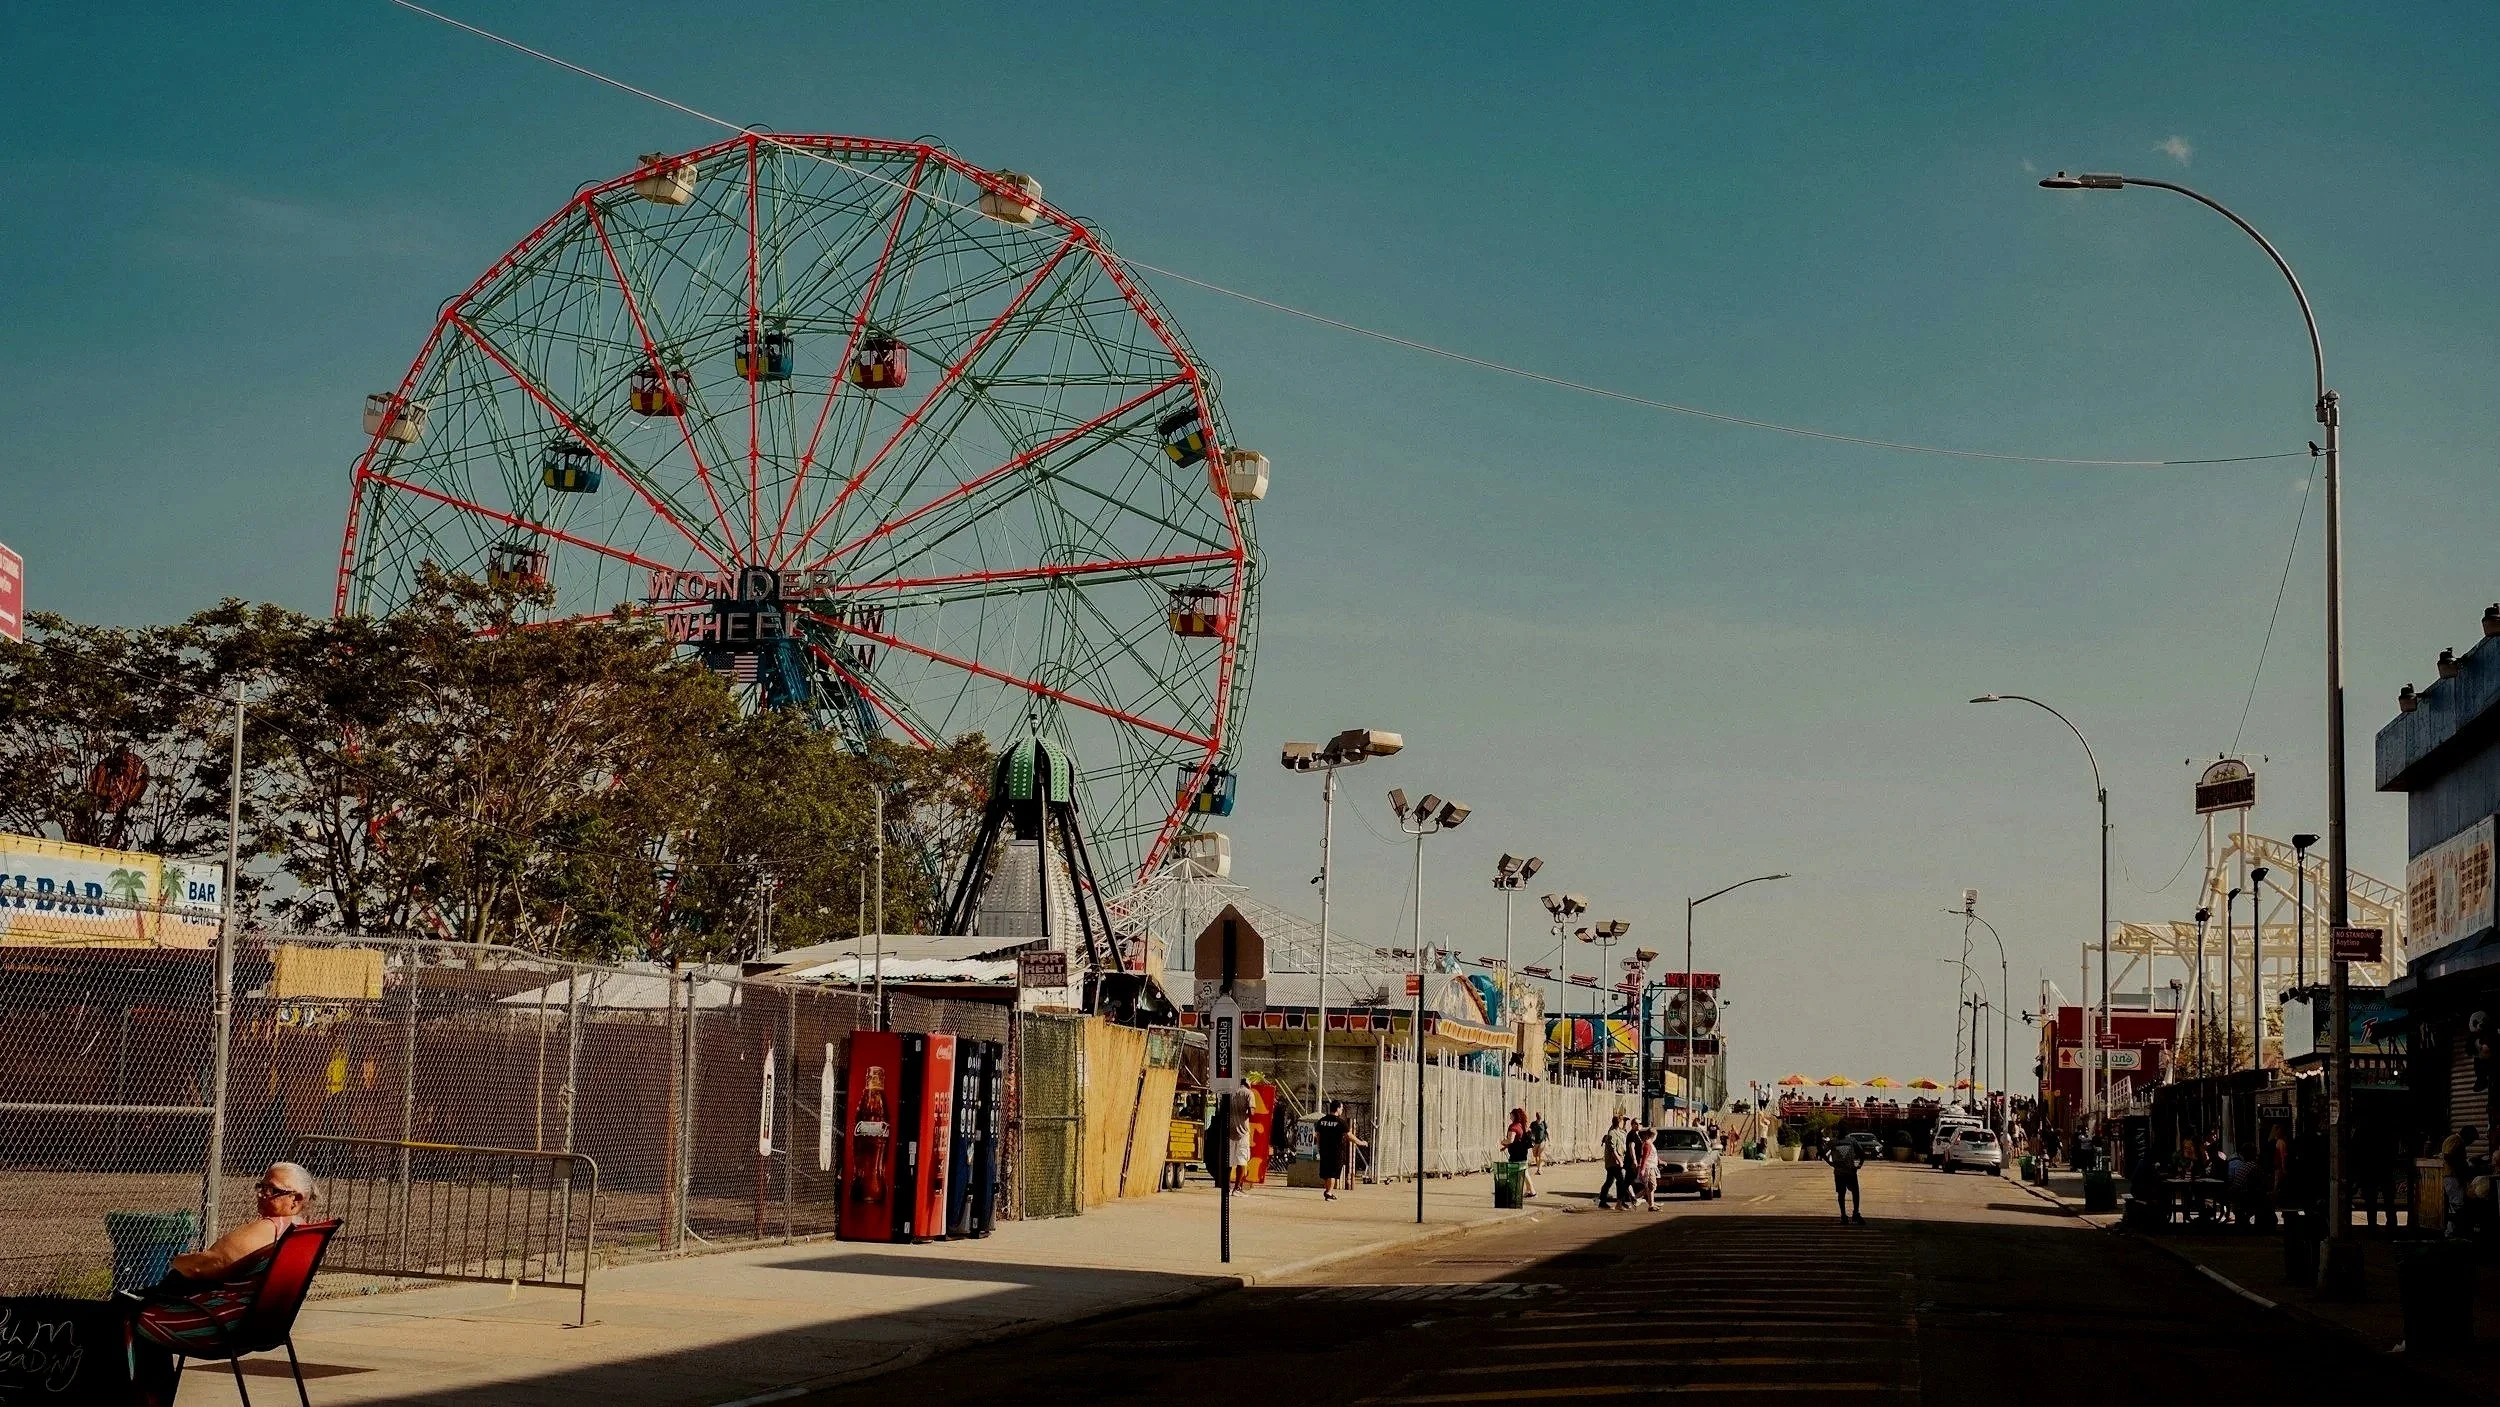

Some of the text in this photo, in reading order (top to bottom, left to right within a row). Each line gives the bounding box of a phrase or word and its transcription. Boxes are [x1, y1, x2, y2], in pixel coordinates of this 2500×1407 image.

[650, 569, 837, 601] WONDER
[664, 611, 807, 643] WHEEL
[189, 881, 216, 903] BAR
[1025, 963, 1064, 974] RENT
[1030, 954, 1061, 964] FOR
[1219, 1020, 1228, 1066] essentia
[2264, 1107, 2289, 1118] ATM
